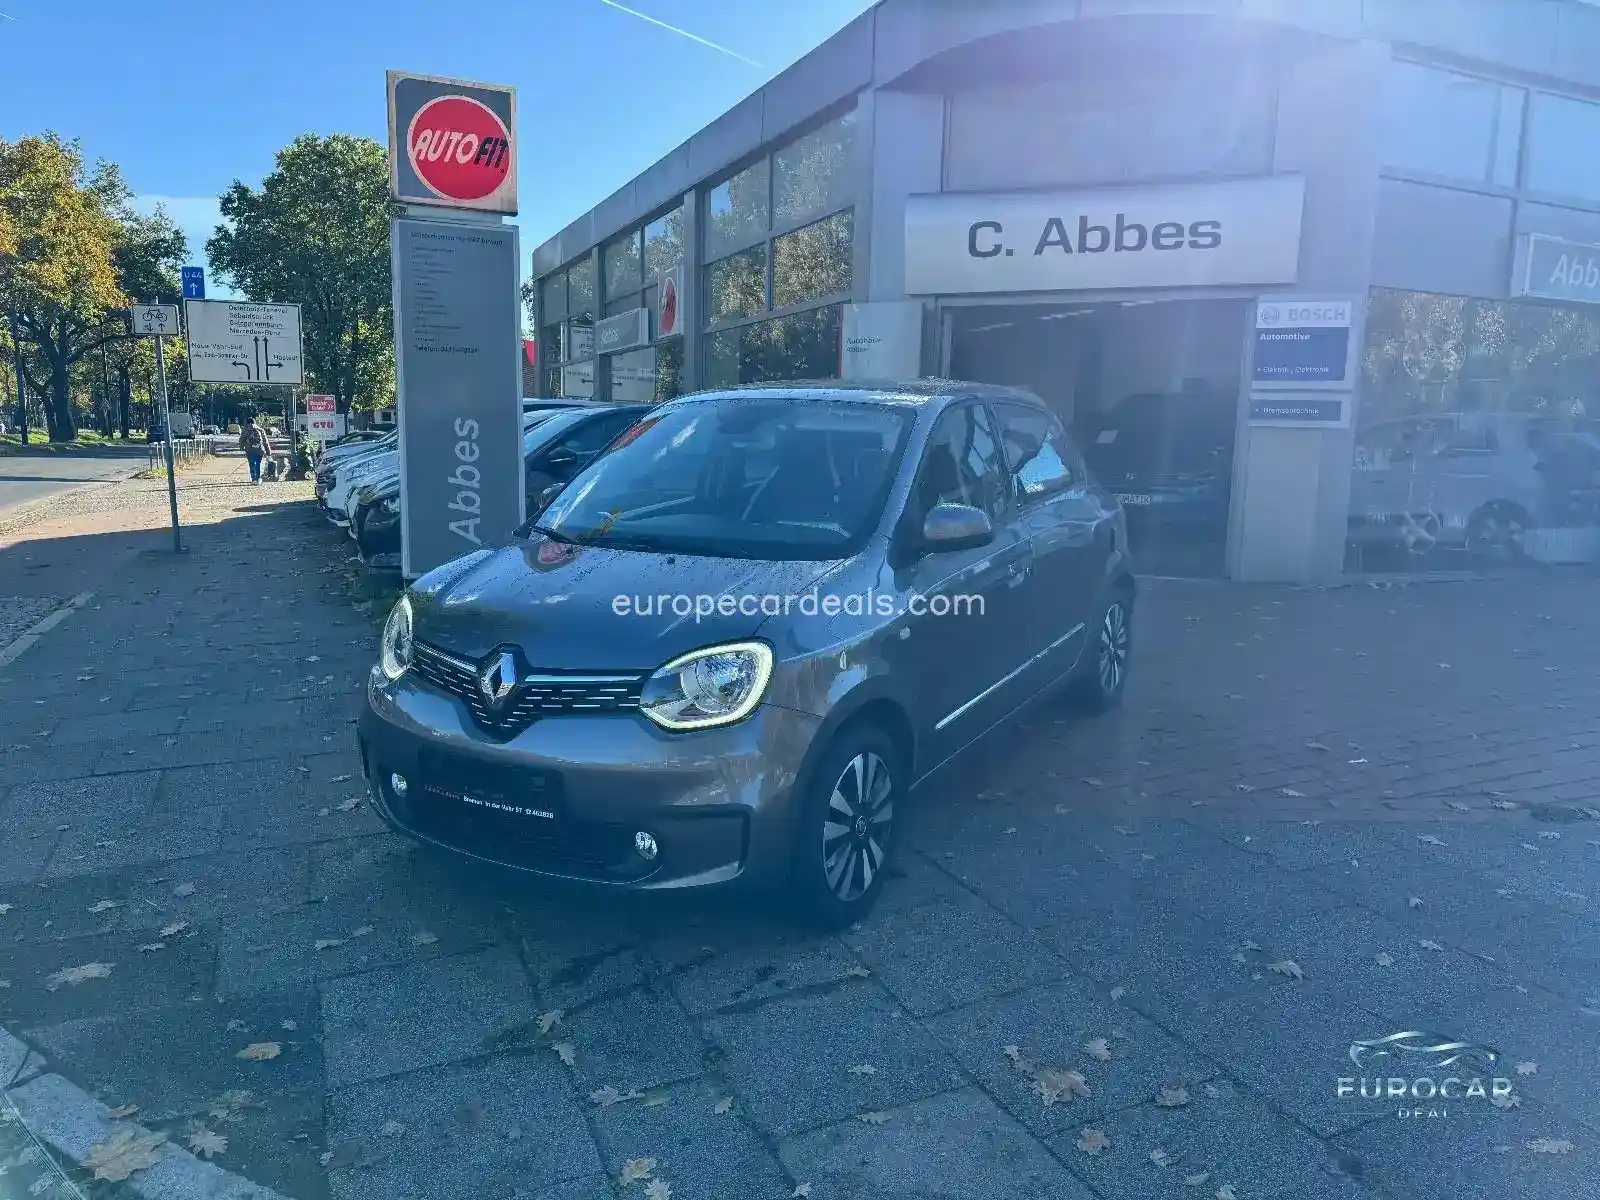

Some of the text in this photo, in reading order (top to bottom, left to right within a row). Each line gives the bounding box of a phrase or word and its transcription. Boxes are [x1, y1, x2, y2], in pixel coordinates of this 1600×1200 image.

[968, 213, 1222, 258] C. Abbes
[1549, 253, 1600, 289] Abb
[1288, 307, 1345, 321] BOSCH
[1260, 333, 1310, 341] Automotive
[447, 416, 482, 546] Abbes
